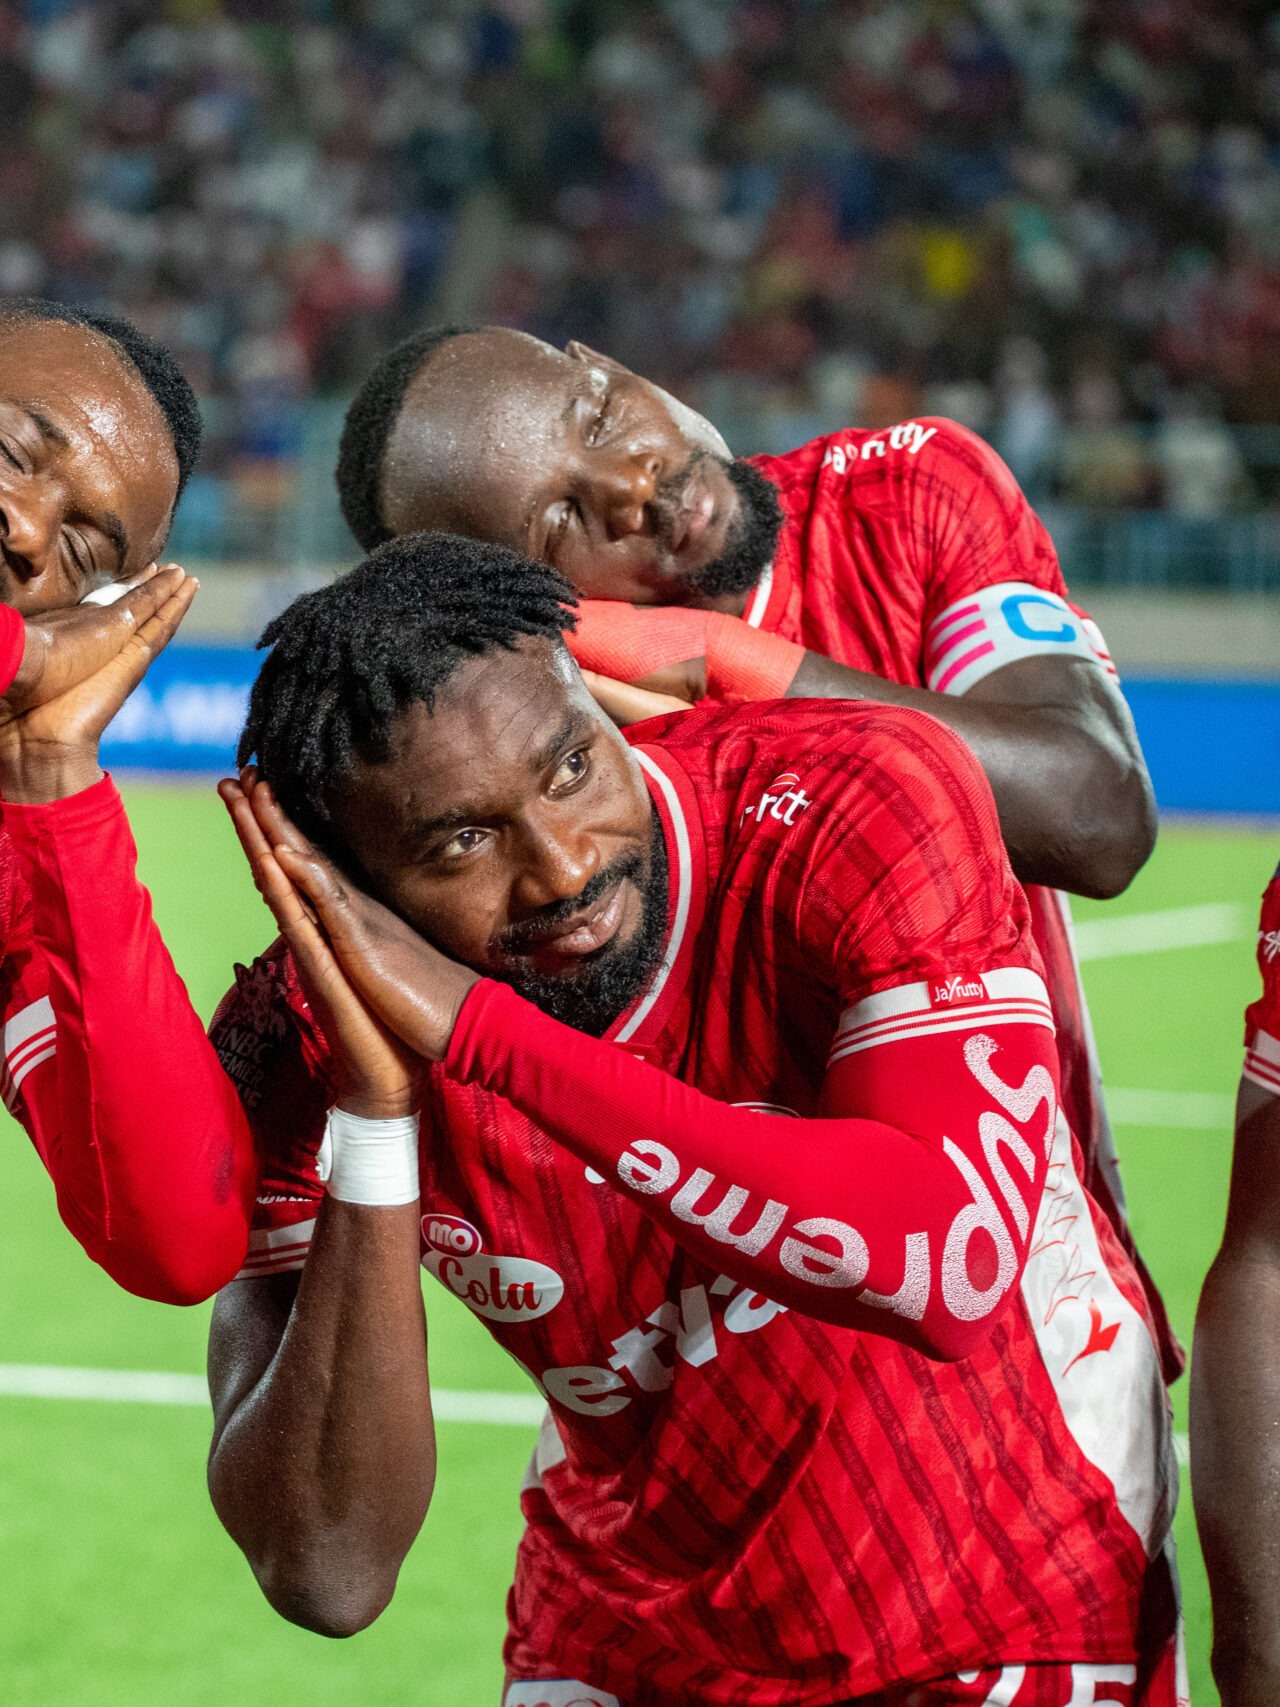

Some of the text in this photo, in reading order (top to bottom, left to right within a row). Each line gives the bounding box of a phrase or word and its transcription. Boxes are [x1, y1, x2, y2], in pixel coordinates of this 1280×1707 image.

[1000, 594, 1077, 643] C
[616, 1032, 1057, 1322] Supreme
[437, 1255, 544, 1311] Cola
